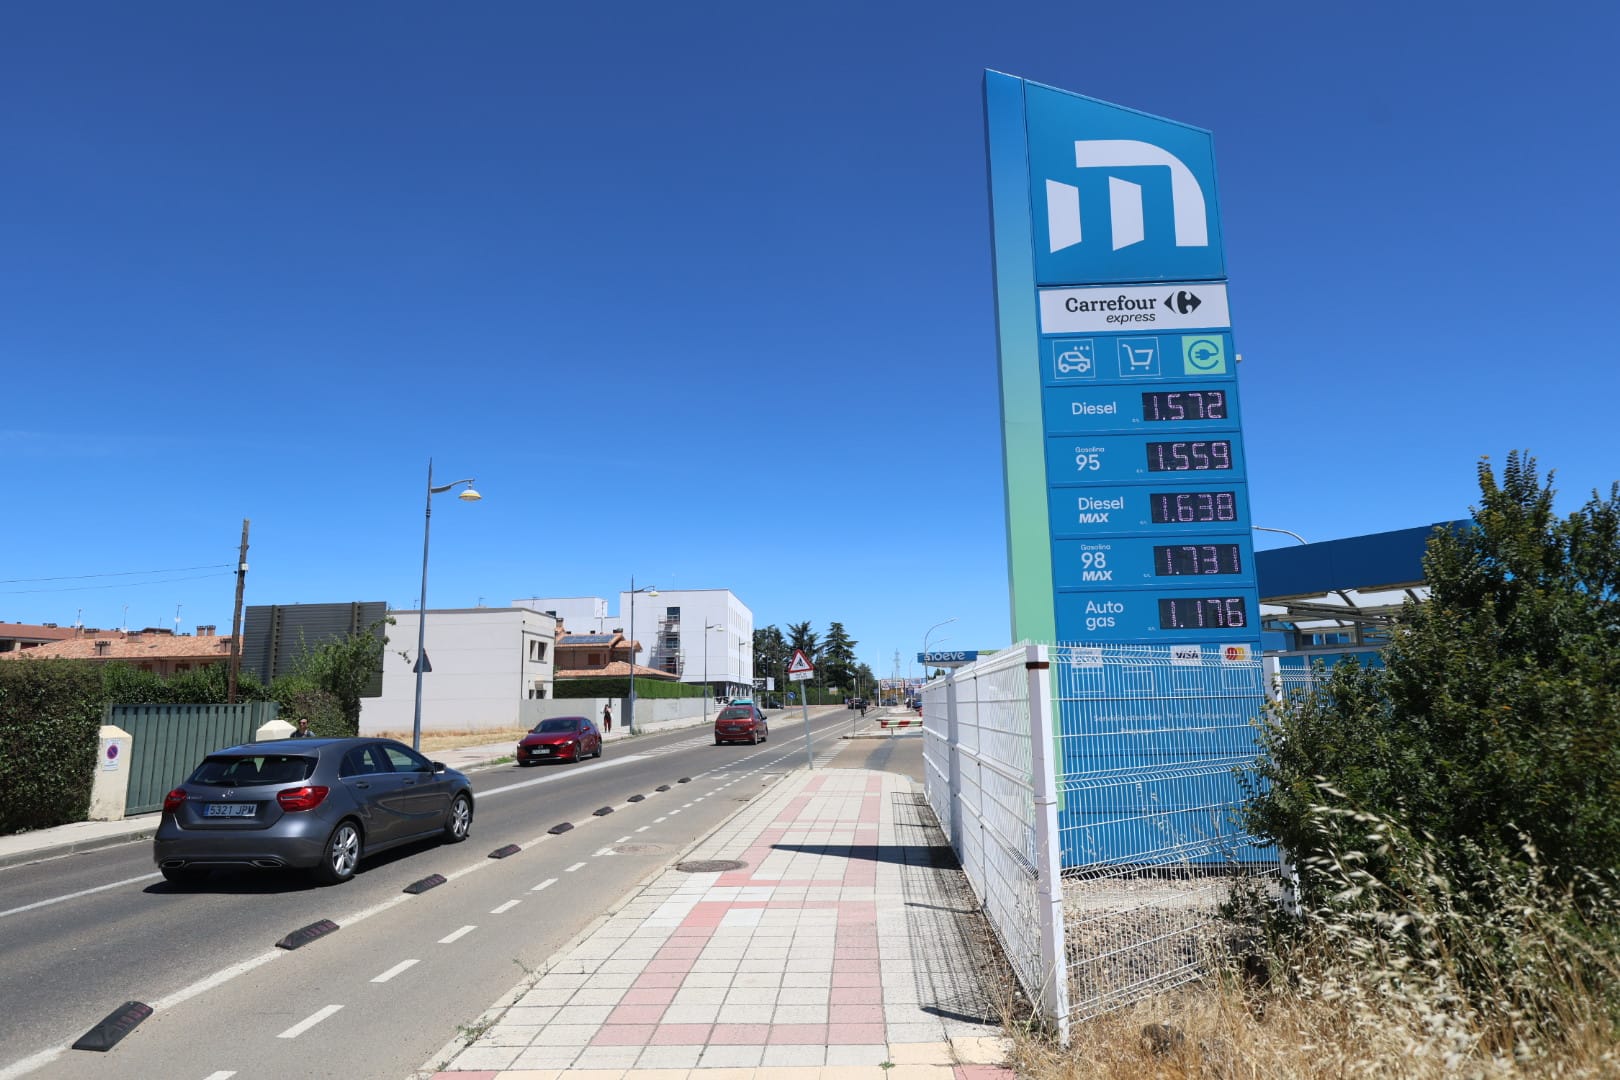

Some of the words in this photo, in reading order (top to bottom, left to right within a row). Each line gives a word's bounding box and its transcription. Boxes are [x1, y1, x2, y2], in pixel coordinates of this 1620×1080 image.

[1065, 295, 1157, 312] Carrefour
[1106, 313, 1156, 325] express
[1071, 401, 1117, 415] Diesel
[1153, 392, 1222, 420] 1.572
[1075, 454, 1100, 471] 95
[1157, 442, 1229, 470] 1.559
[1077, 496, 1124, 511] Diesel
[1162, 493, 1234, 522] 1.638
[1079, 512, 1109, 523] MAX
[1080, 543, 1111, 551] Gasolina
[1081, 552, 1106, 569] 98
[1166, 546, 1240, 575] 1.731
[1082, 570, 1112, 581] MAX
[1085, 600, 1124, 614] Auto
[1170, 599, 1244, 628] 1.176
[1085, 617, 1116, 631] gas
[210, 805, 232, 815] 5321
